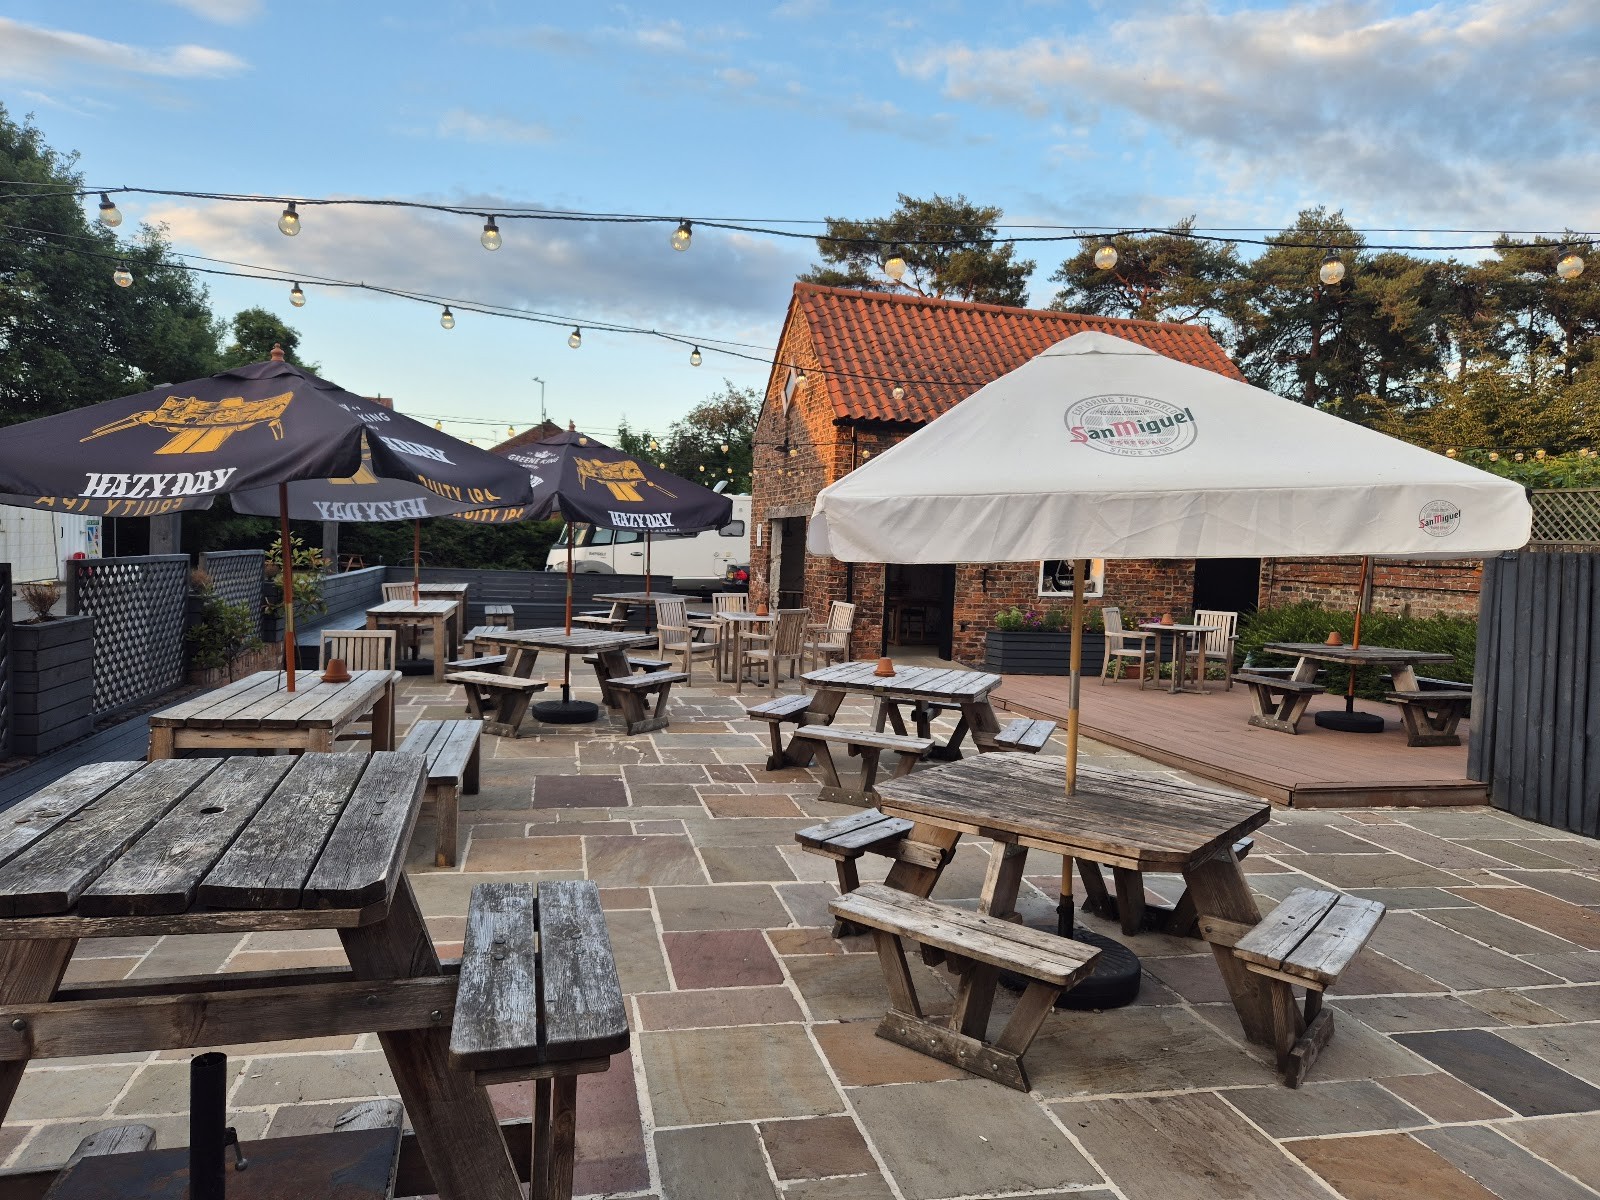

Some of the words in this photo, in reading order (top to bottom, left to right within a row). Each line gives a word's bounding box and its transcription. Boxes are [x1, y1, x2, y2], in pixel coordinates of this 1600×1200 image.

[1071, 396, 1115, 416] EXPLORING
[1119, 396, 1139, 404] THE
[1144, 399, 1178, 415] WORLD
[357, 412, 391, 422] KING
[1109, 447, 1143, 455] SINCE
[508, 454, 540, 464] GREENE
